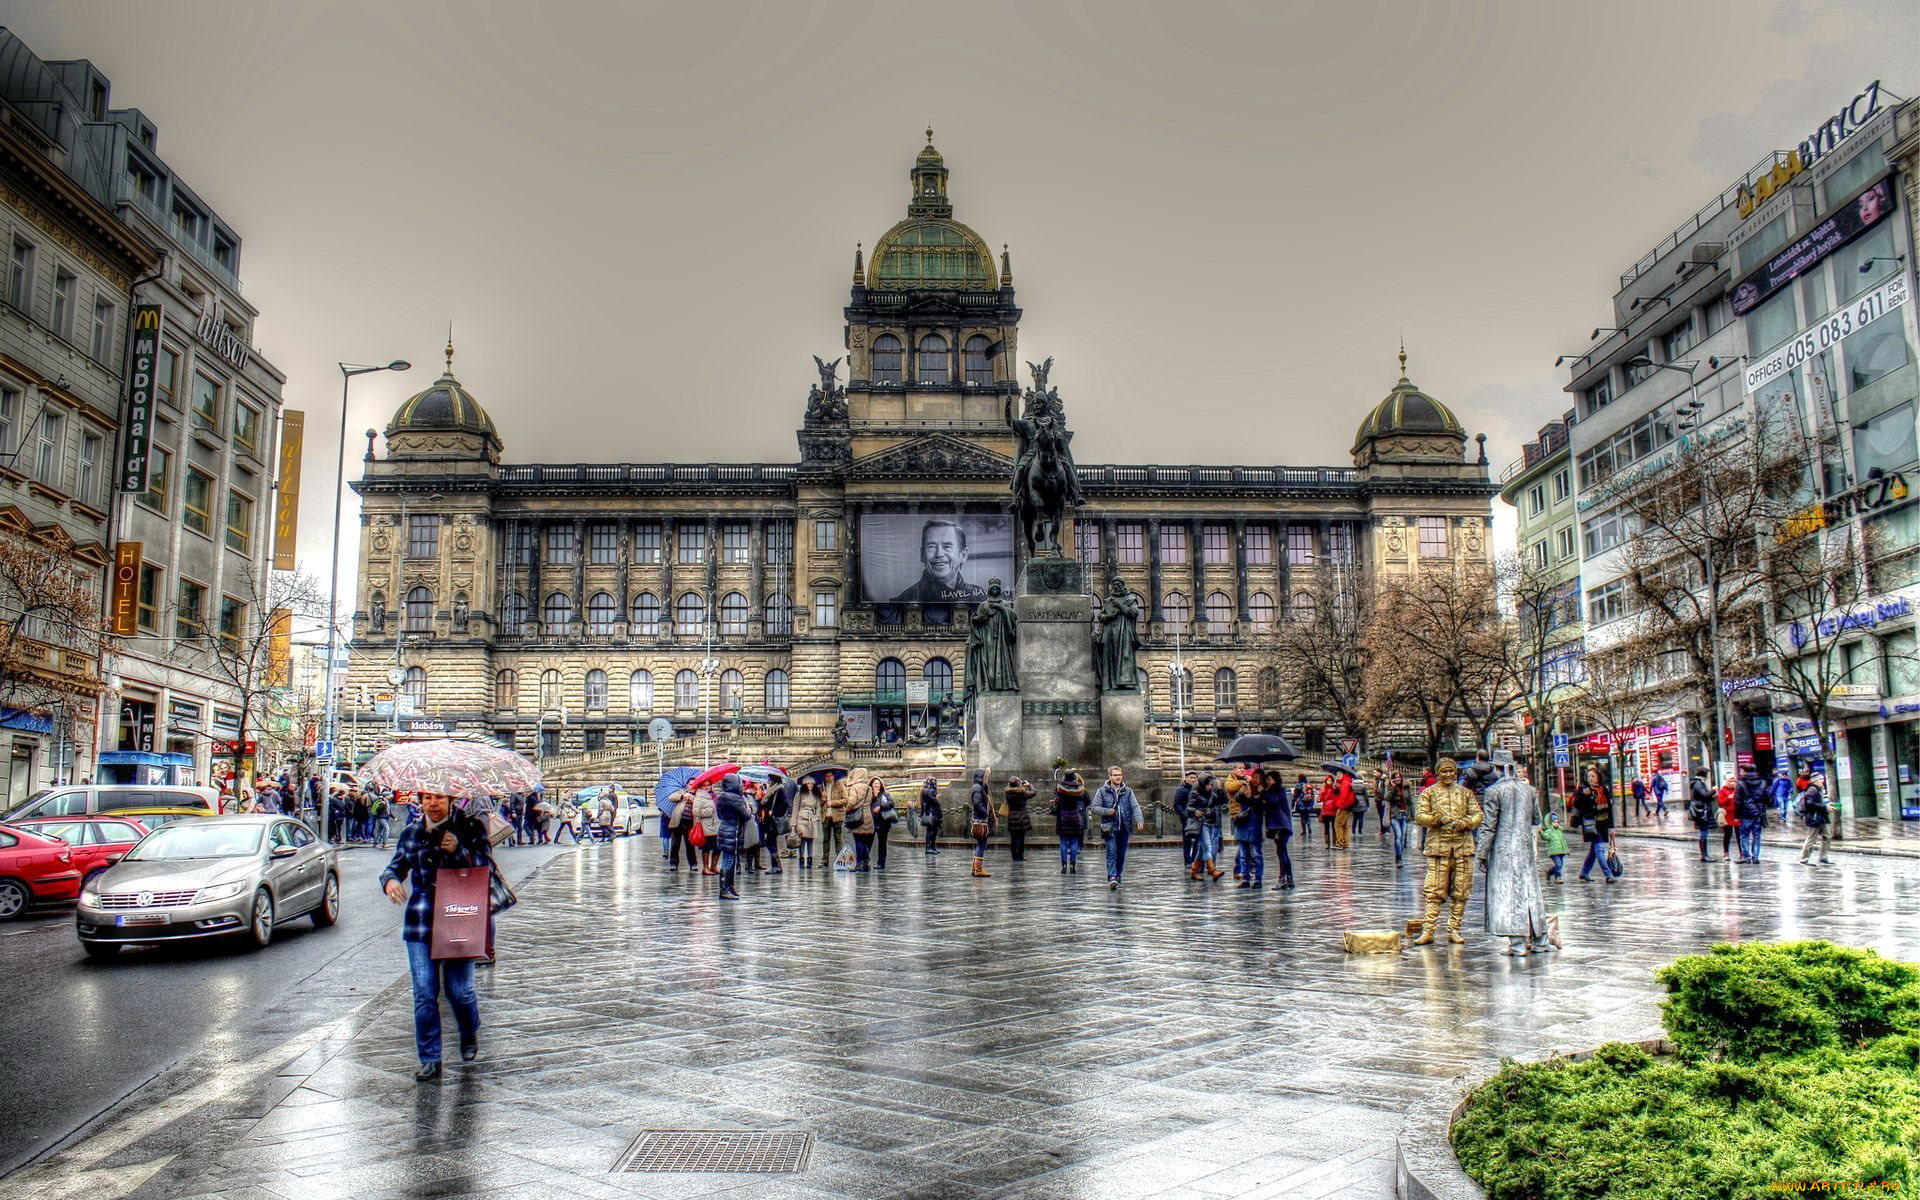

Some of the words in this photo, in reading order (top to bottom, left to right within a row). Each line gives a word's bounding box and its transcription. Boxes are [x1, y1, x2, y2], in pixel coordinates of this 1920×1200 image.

[1887, 277, 1905, 296] FOR
[1887, 289, 1908, 310] RENT
[1748, 357, 1783, 386] OFFICES
[1786, 334, 1815, 369] 605
[1819, 310, 1852, 348] 083
[1857, 291, 1884, 326] 611
[118, 550, 134, 631] HOTEL
[941, 589, 971, 600] HAVEL
